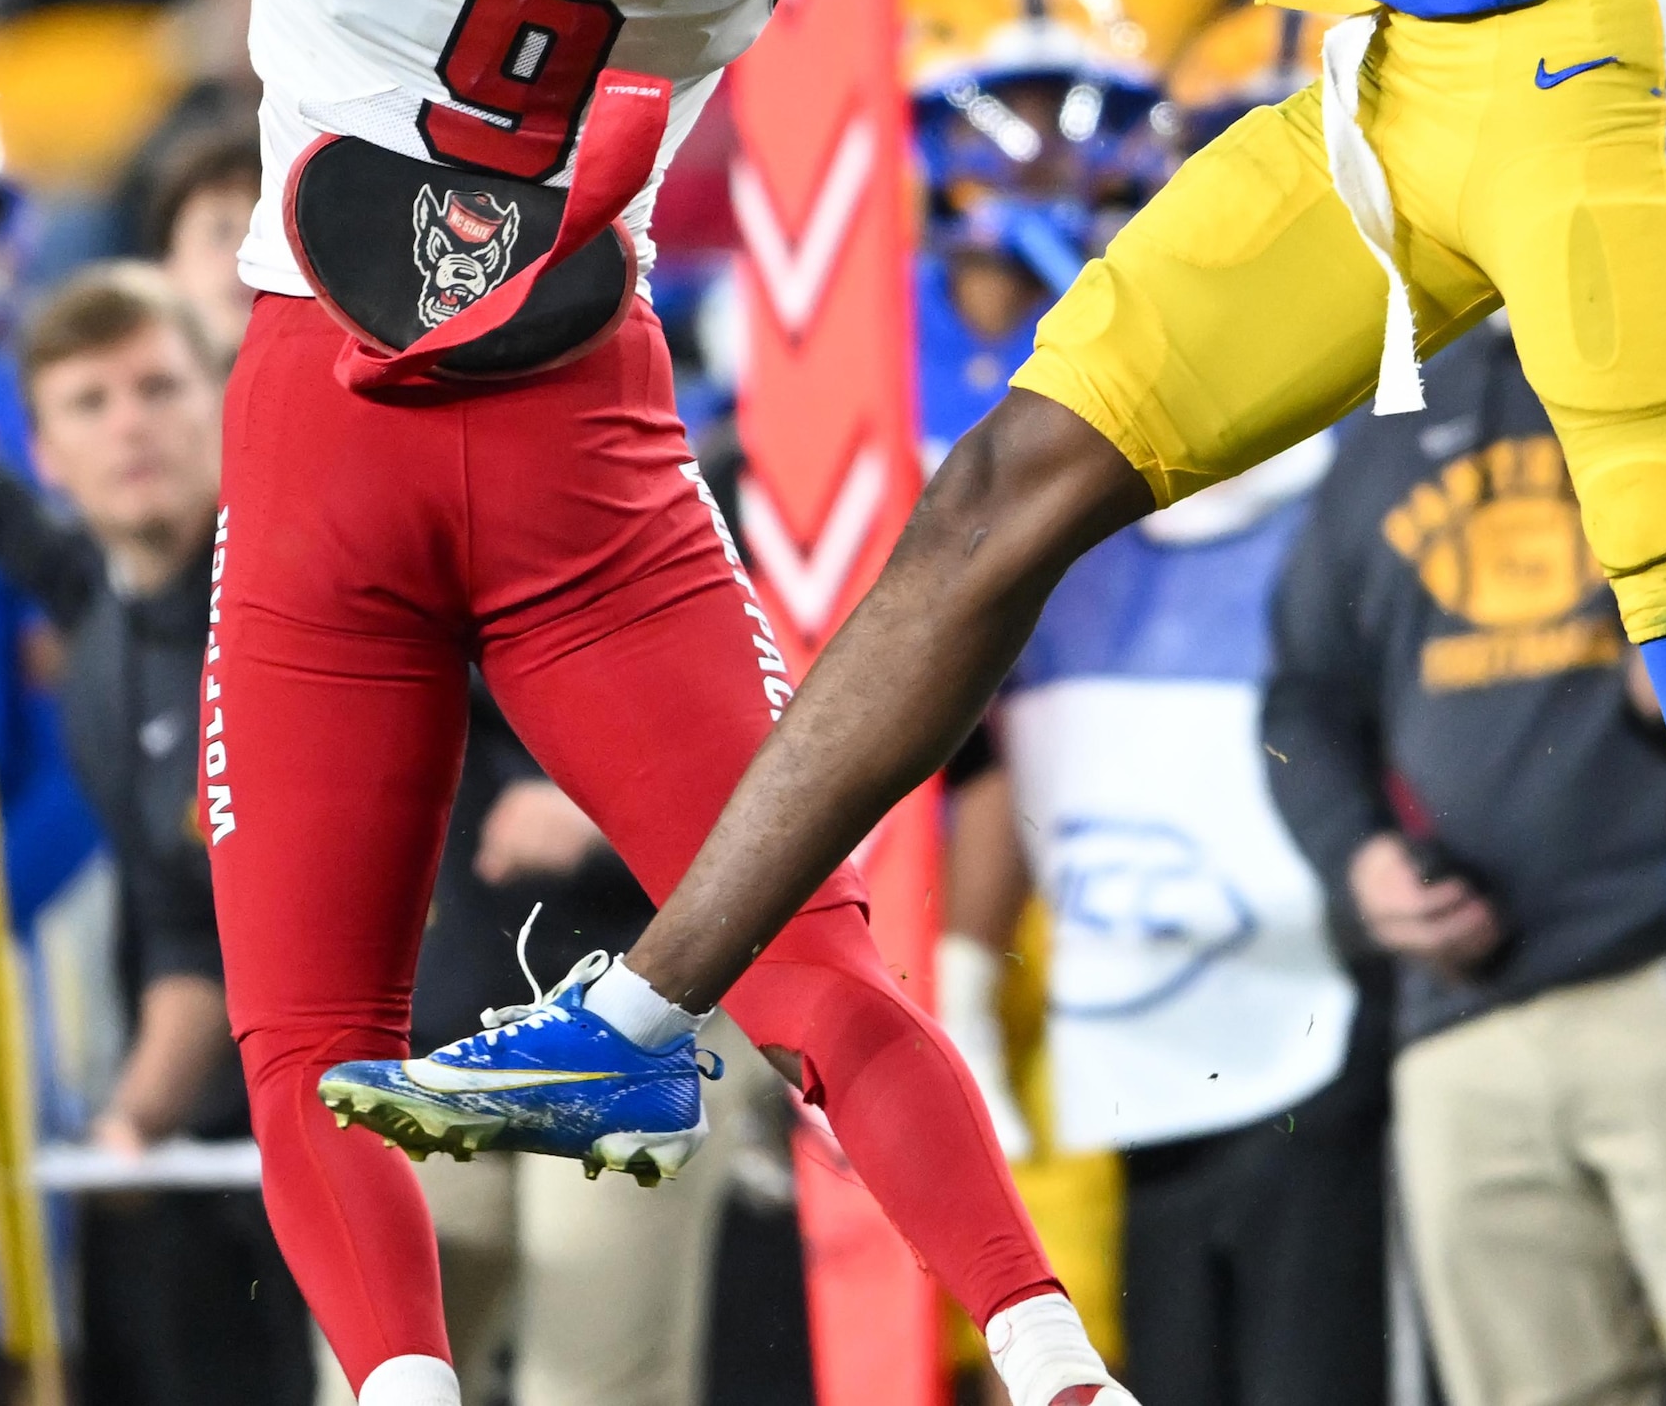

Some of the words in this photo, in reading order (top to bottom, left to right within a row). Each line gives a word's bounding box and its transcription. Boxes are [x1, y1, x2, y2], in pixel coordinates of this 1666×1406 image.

[450, 210, 464, 228] NC
[462, 222, 490, 240] STATE
[678, 459, 794, 722] WOLFPAC
